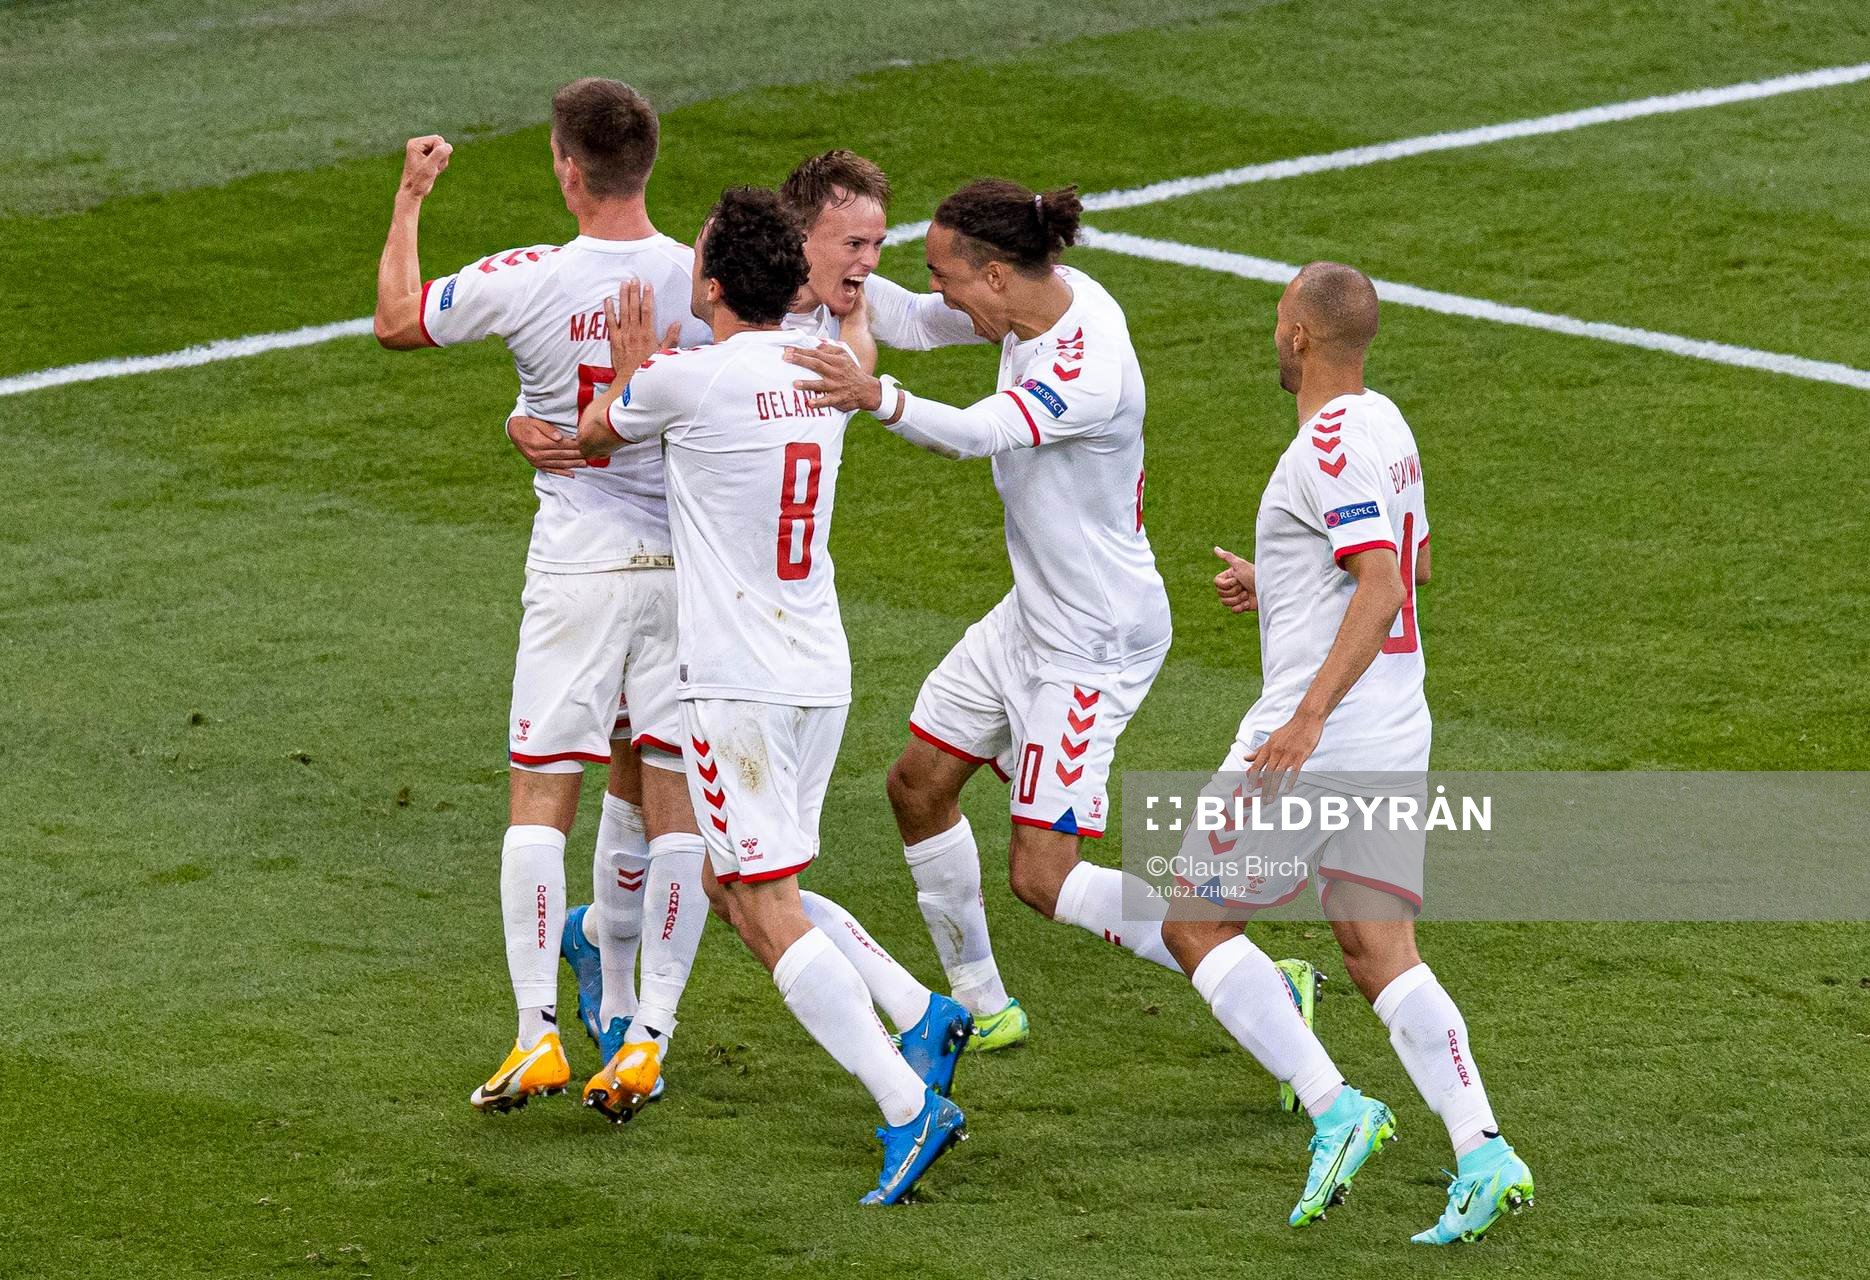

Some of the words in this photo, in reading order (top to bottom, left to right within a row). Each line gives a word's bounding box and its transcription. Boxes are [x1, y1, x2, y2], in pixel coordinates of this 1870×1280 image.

[1033, 385, 1065, 414] RESPECT
[777, 442, 822, 581] 8
[1340, 505, 1378, 520] RESPECT
[537, 885, 546, 949] DANMARK
[662, 883, 680, 940] DANMARK
[1447, 1029, 1472, 1087] DANMARK
